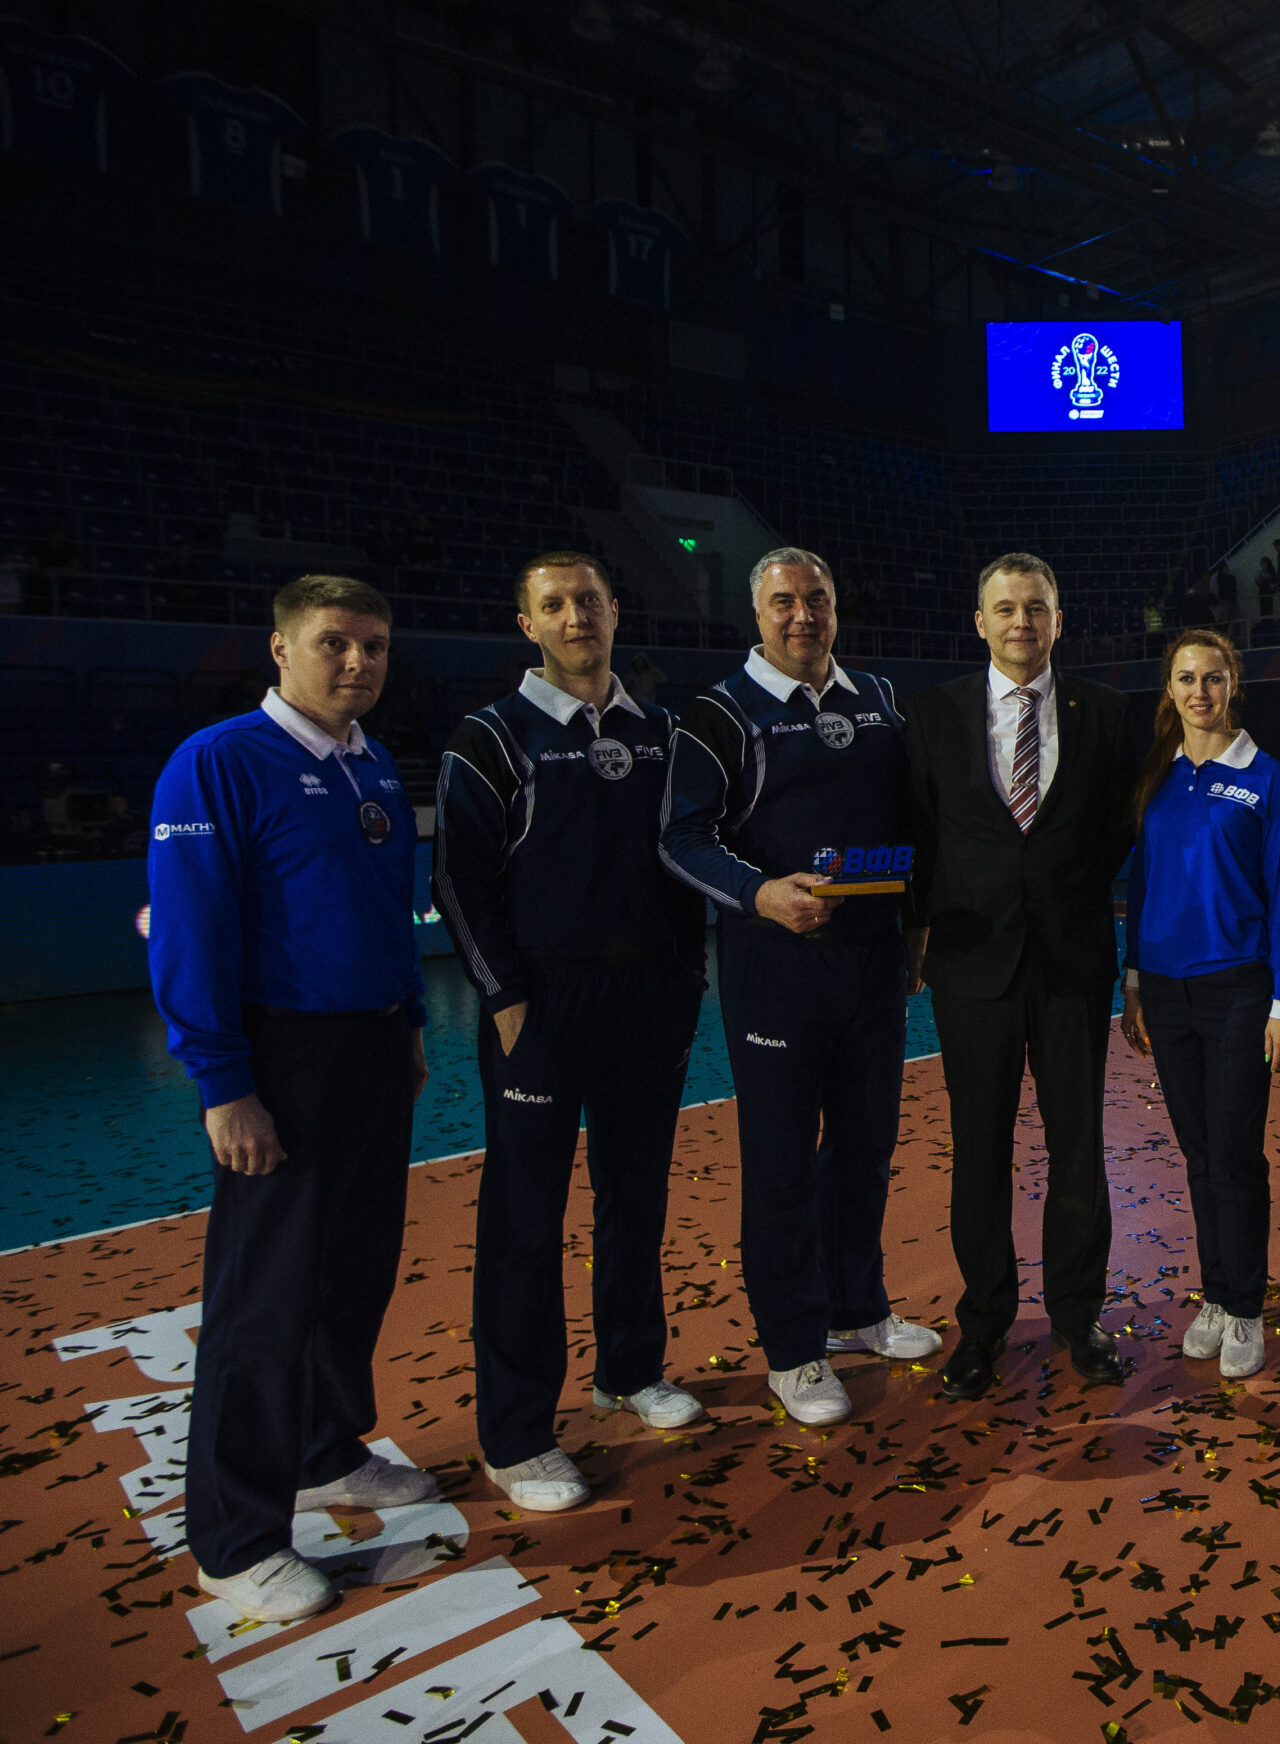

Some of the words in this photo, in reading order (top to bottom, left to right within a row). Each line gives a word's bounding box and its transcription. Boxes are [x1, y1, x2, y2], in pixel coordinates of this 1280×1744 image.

[1051, 345, 1071, 390] ФИНАЛ
[1099, 345, 1120, 388] ШЕСТИ
[1062, 366, 1076, 376] 20
[1096, 366, 1108, 375] 22
[854, 712, 882, 722] FIVB
[820, 721, 845, 732] FIVB
[594, 748, 622, 760] FIVB
[1223, 785, 1260, 805] ВФВ
[843, 845, 914, 874] ВФВ
